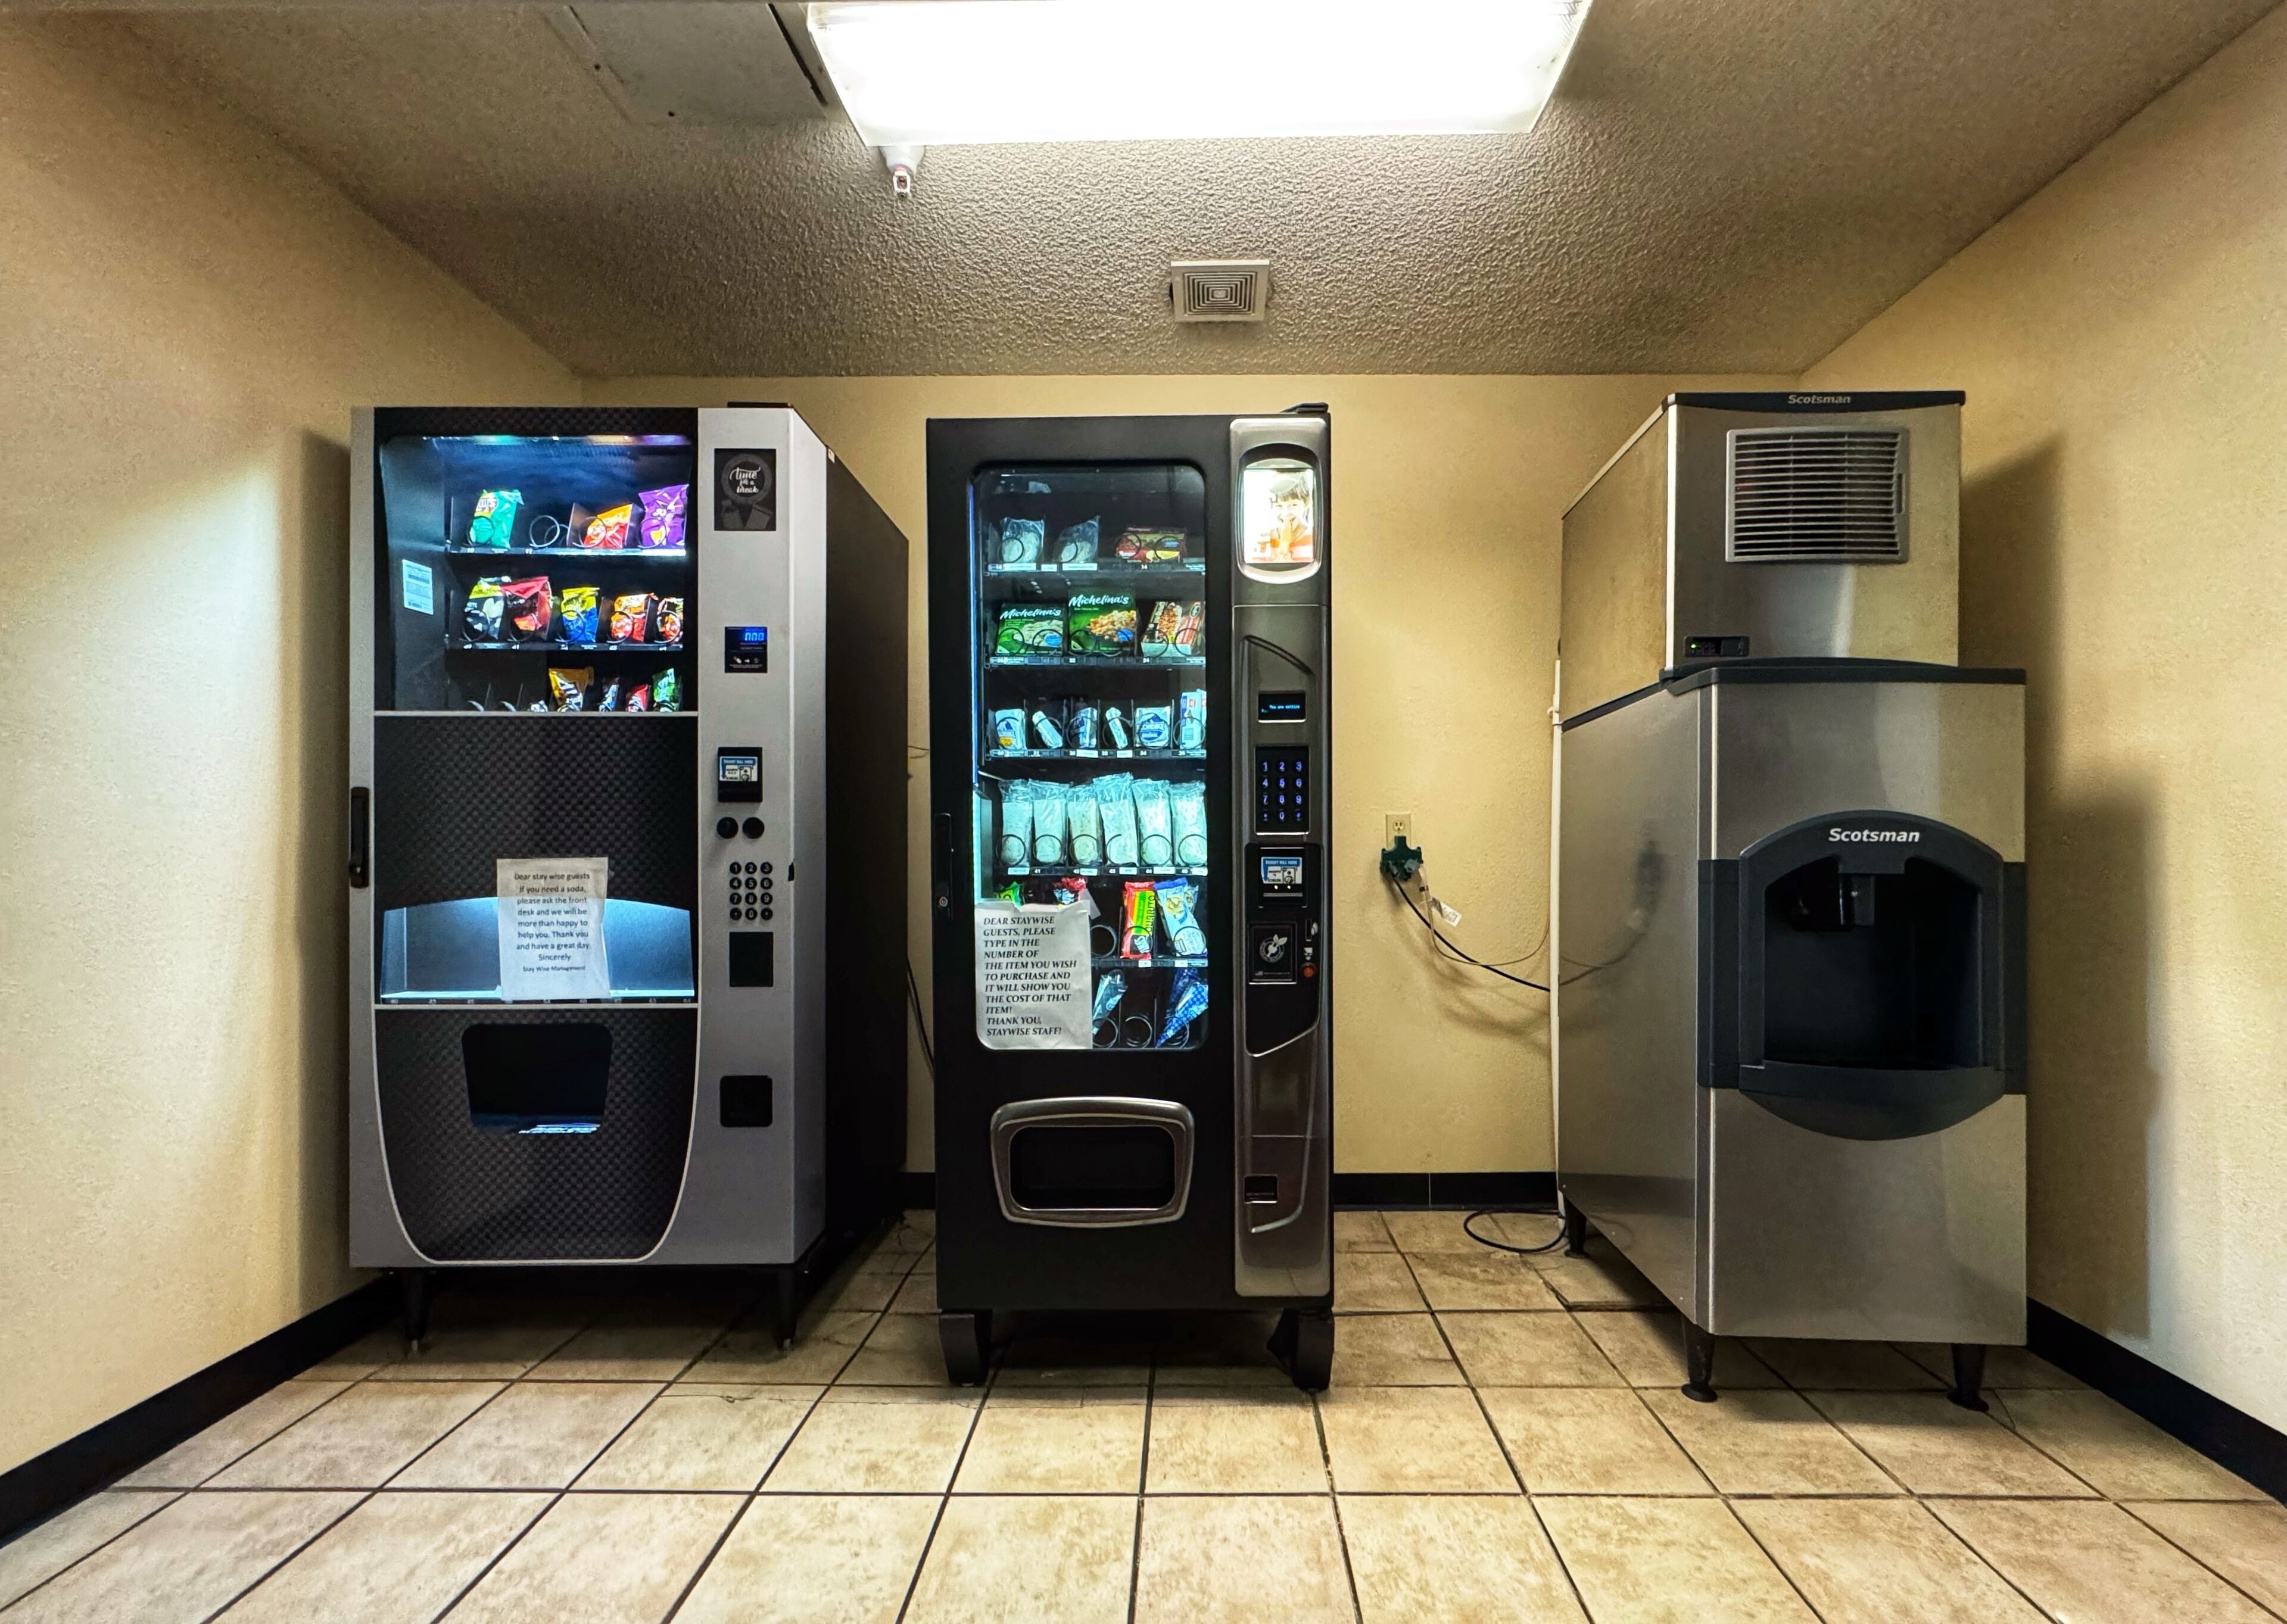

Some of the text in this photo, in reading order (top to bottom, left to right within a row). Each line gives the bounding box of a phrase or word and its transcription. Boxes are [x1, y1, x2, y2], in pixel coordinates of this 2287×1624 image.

[1788, 395, 1850, 404] Scotsman
[730, 467, 761, 479] time
[1068, 594, 1129, 607] Michelina's
[1000, 609, 1061, 620] Michelina's
[1263, 762, 1302, 771] 1 2 3
[1263, 778, 1302, 787] 4 5 6
[1263, 795, 1301, 803] 7 8 9
[1279, 812, 1285, 820] 0
[1828, 828, 1920, 842] Scotsman
[566, 873, 590, 881] guests
[556, 919, 578, 929] happy
[518, 931, 534, 940] help
[1023, 927, 1056, 936] PLEASE
[1019, 939, 1040, 947] THE
[984, 951, 1023, 959] NUMBER
[985, 962, 1004, 970] THE
[1000, 972, 1049, 981] PURCHASE
[1007, 995, 1030, 1003] COST
[987, 1017, 1020, 1025] THANK
[1032, 1027, 1061, 1035] STAFF!
